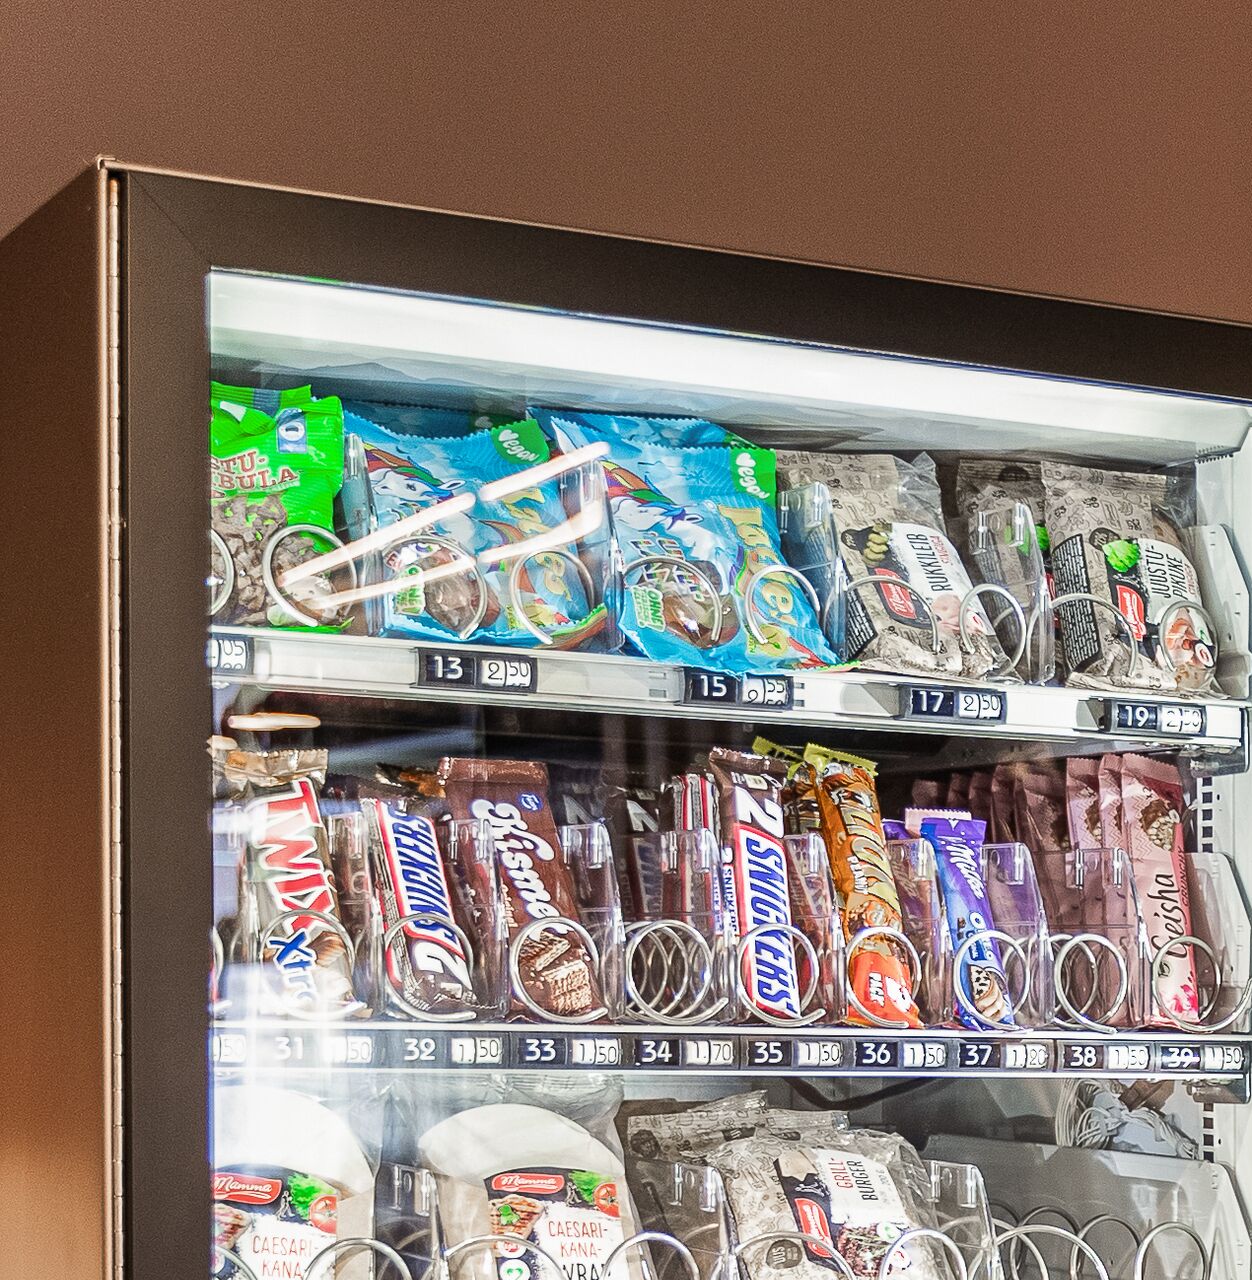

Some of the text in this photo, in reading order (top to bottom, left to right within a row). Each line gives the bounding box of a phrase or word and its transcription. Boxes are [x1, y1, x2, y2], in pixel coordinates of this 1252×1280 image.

[211, 468, 299, 489] BULA
[906, 533, 953, 592] RUKKILEIB
[1145, 545, 1172, 599] JUUSTU-
[1166, 554, 1189, 600] PIKUKE
[433, 655, 464, 680] 13
[699, 675, 727, 698] 15
[917, 690, 943, 713] 17
[1124, 704, 1148, 727] 19
[735, 786, 785, 840] 2
[262, 778, 335, 934] TWIX
[387, 803, 458, 947] SNICKERS
[944, 841, 985, 901] Milka
[745, 836, 798, 1015] SNICKERS
[1150, 872, 1191, 961] Geisha
[274, 1036, 305, 1061] 31
[403, 1037, 437, 1061] 32
[524, 1038, 557, 1062] 33
[641, 1040, 673, 1063] 34
[753, 1041, 784, 1064] 35
[861, 1042, 891, 1065] 36
[964, 1043, 993, 1066] 37
[1070, 1044, 1098, 1067] 38
[1165, 1046, 1195, 1067] 39
[215, 1175, 273, 1199] Mamma
[500, 1173, 558, 1189] Mamma
[846, 1158, 879, 1203] BURGER
[548, 1220, 609, 1239] CAESARI-
[252, 1235, 319, 1257] CAESARI-
[560, 1241, 603, 1258] KANA-
